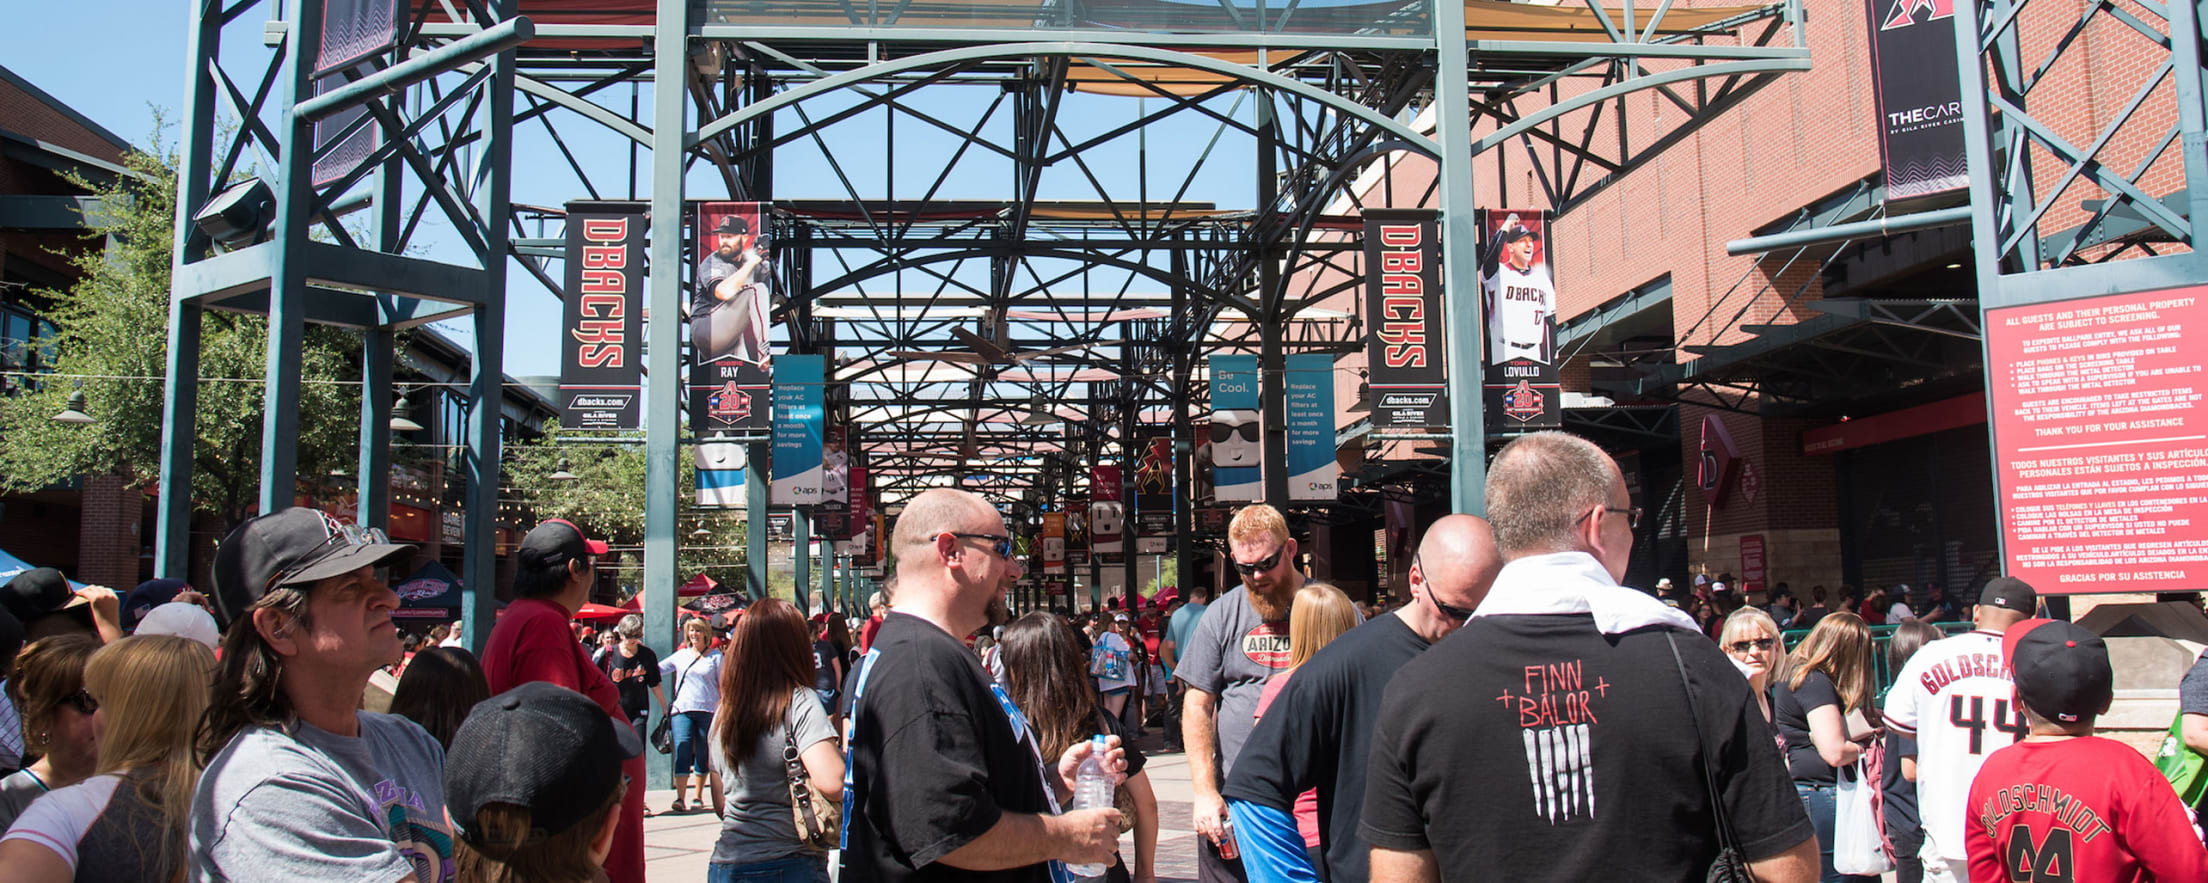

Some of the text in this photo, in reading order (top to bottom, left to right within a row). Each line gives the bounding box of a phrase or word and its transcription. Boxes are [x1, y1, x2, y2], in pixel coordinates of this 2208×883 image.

[1534, 310, 1544, 326] 17
[2005, 298, 2195, 326] ALL GUESTS AND THEIR PERSONAL PROPERTY
[2039, 311, 2160, 331] ARE SUBJECT TO SCREENING.
[721, 367, 738, 378] RAY
[1219, 371, 1233, 380] Be
[1504, 366, 1539, 377] LOVULLO
[1218, 383, 1249, 392] Cool.
[577, 398, 624, 406] dbacks.com
[719, 394, 740, 409] 20
[1386, 396, 1430, 404] dbacks.com
[1514, 392, 1532, 407] 20
[2035, 418, 2184, 436] THANK YOU FOR YOUR ASSISTANCE
[2011, 461, 2037, 469] TODOS
[2040, 458, 2083, 467] NUESTROS
[2086, 454, 2135, 464] VISITANTES
[2147, 452, 2165, 460] SUS
[2019, 468, 2072, 478] PERSONALES
[2074, 464, 2102, 474] ESTÁN
[2104, 463, 2141, 473] SUJETOS
[2059, 574, 2096, 582] GRACIAS
[2133, 572, 2186, 580] ASISTENCIA
[1248, 636, 1290, 651] ARIZO
[1525, 659, 1582, 694] FINN
[1950, 694, 2030, 755] 44
